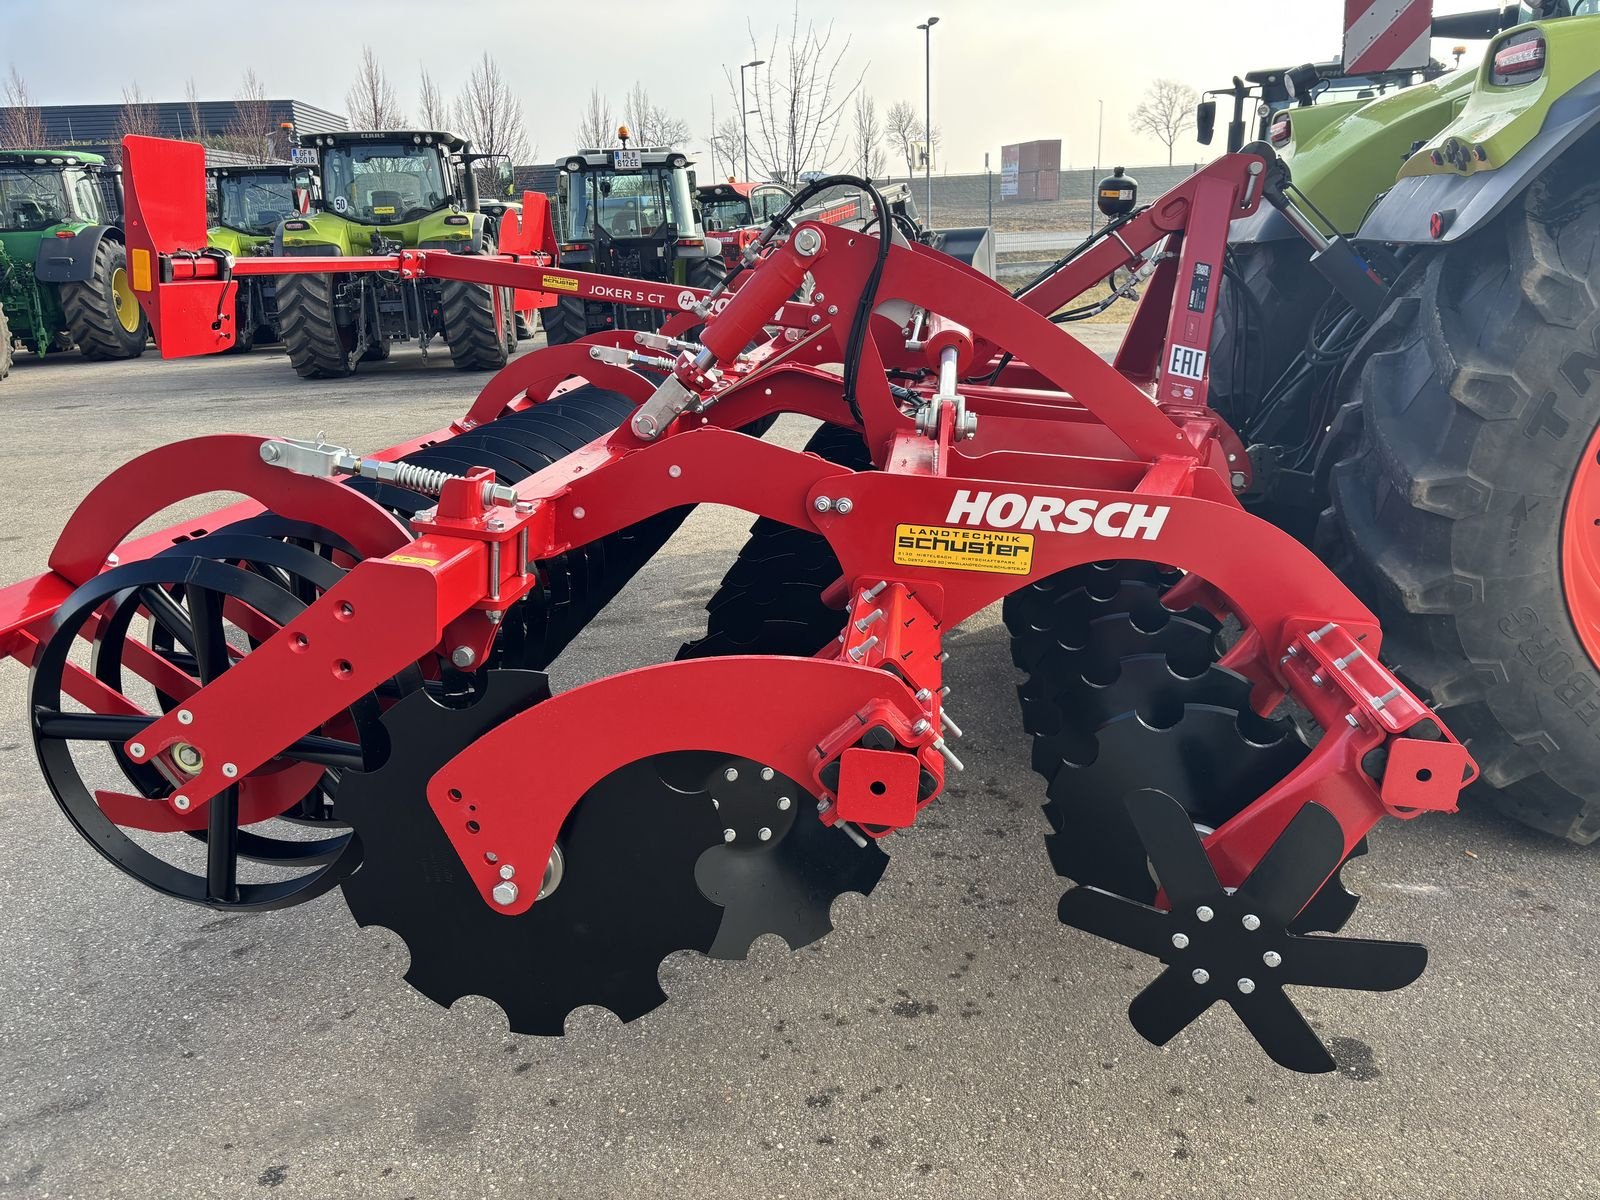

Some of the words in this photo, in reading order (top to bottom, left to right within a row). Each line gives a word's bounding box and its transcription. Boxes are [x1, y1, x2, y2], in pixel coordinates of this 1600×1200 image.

[336, 200, 346, 210] 50
[588, 285, 632, 300] JOKER
[636, 292, 644, 301] 5
[647, 293, 665, 305] CT
[1171, 347, 1203, 378] EAC
[945, 489, 1171, 541] HORSCH
[909, 527, 1020, 543] LANDTECHNIK
[898, 536, 1030, 557] schuster
